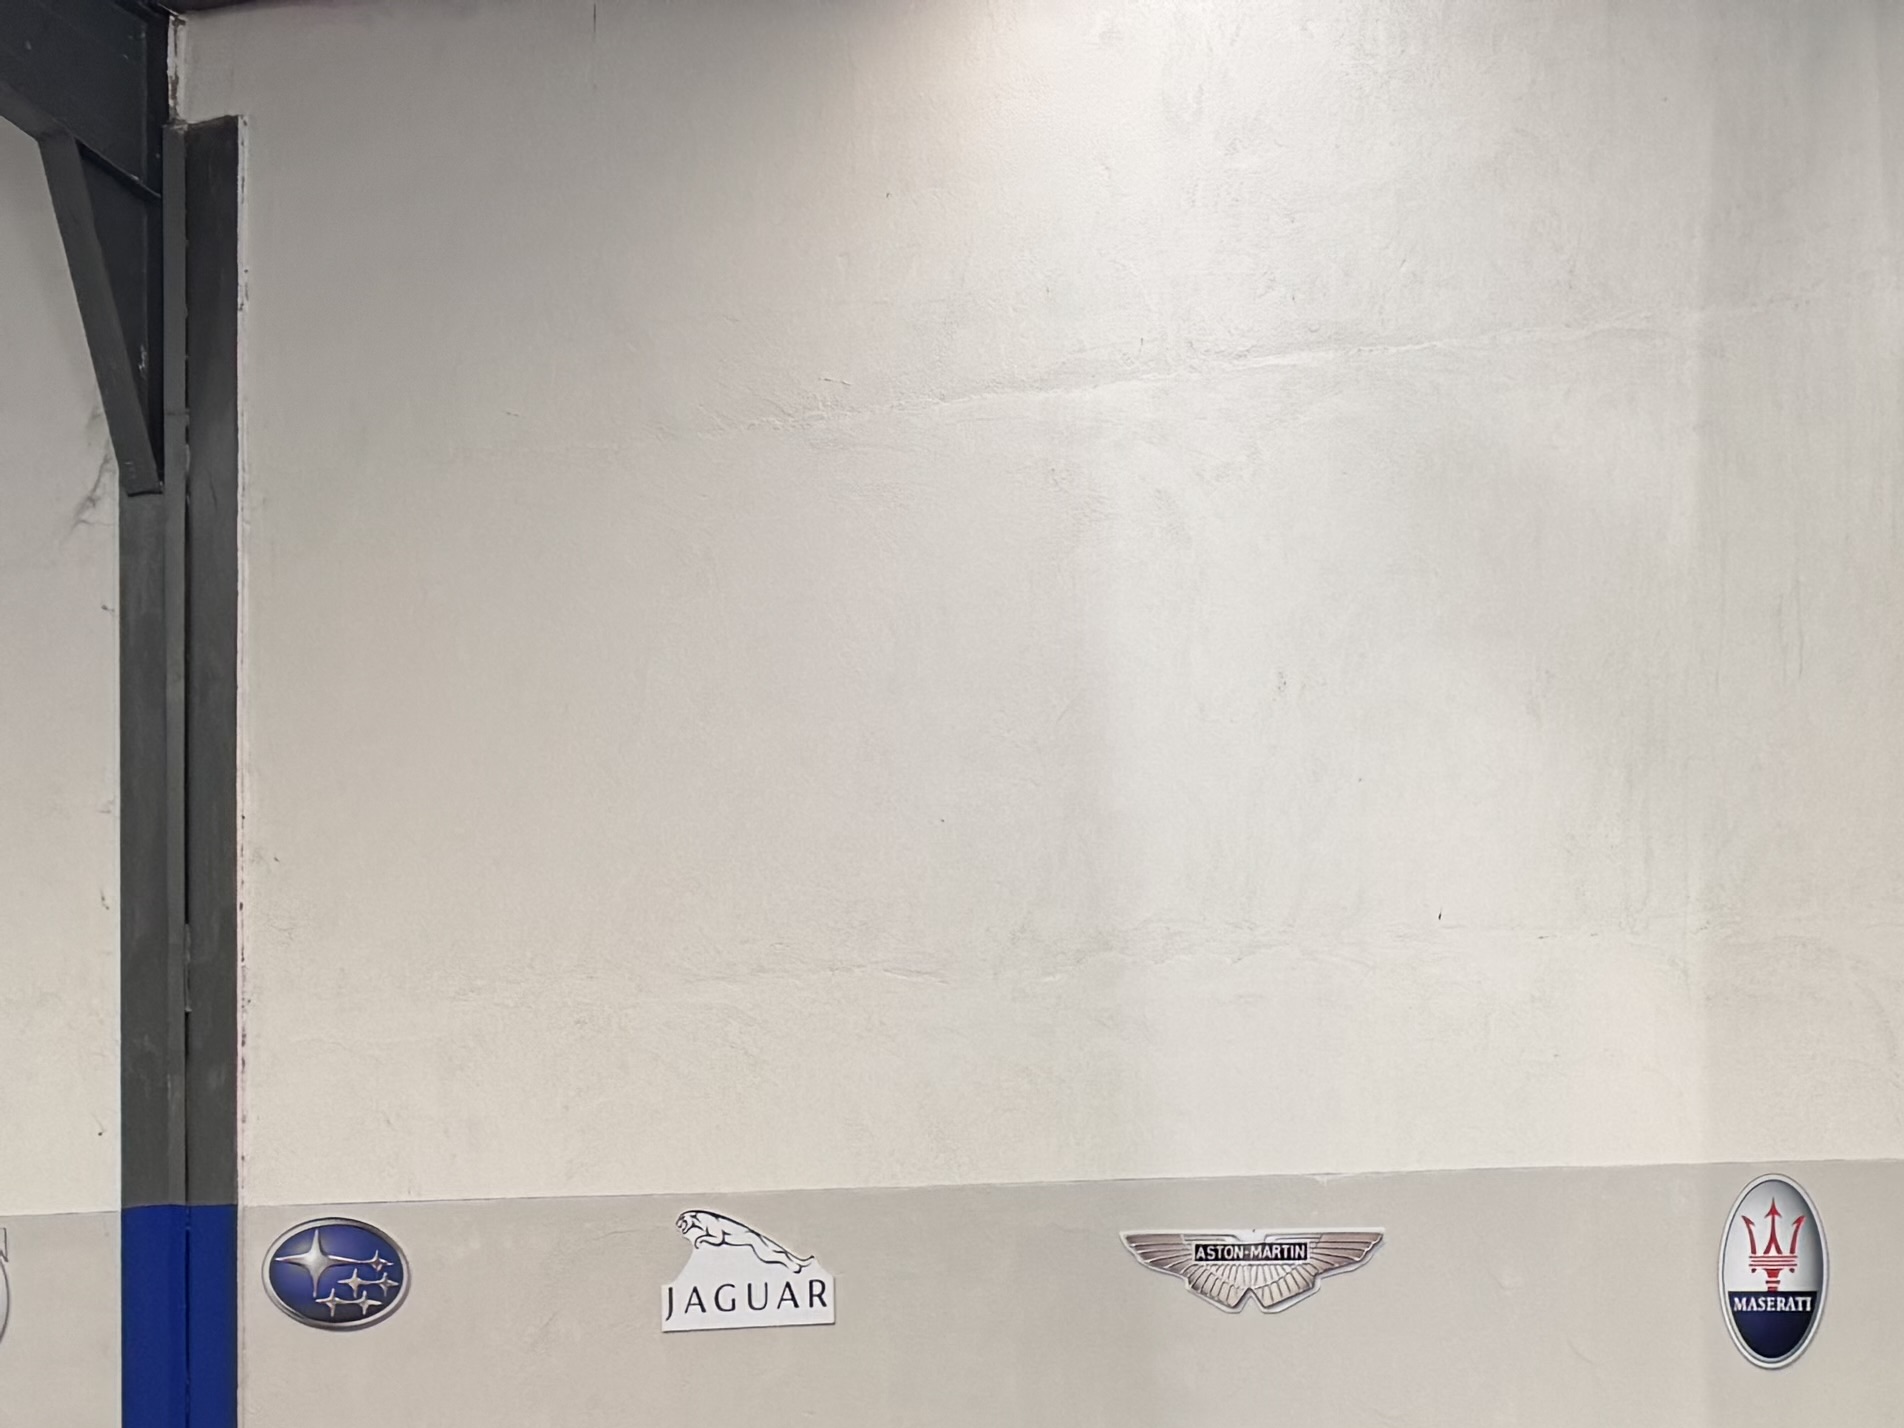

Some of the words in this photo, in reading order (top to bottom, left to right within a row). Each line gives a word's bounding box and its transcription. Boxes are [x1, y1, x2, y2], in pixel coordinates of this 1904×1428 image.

[1196, 1244, 1306, 1260] ASTON-MARTIN
[665, 1278, 828, 1322] JAGUAR
[1733, 1296, 1813, 1312] MASERATI
